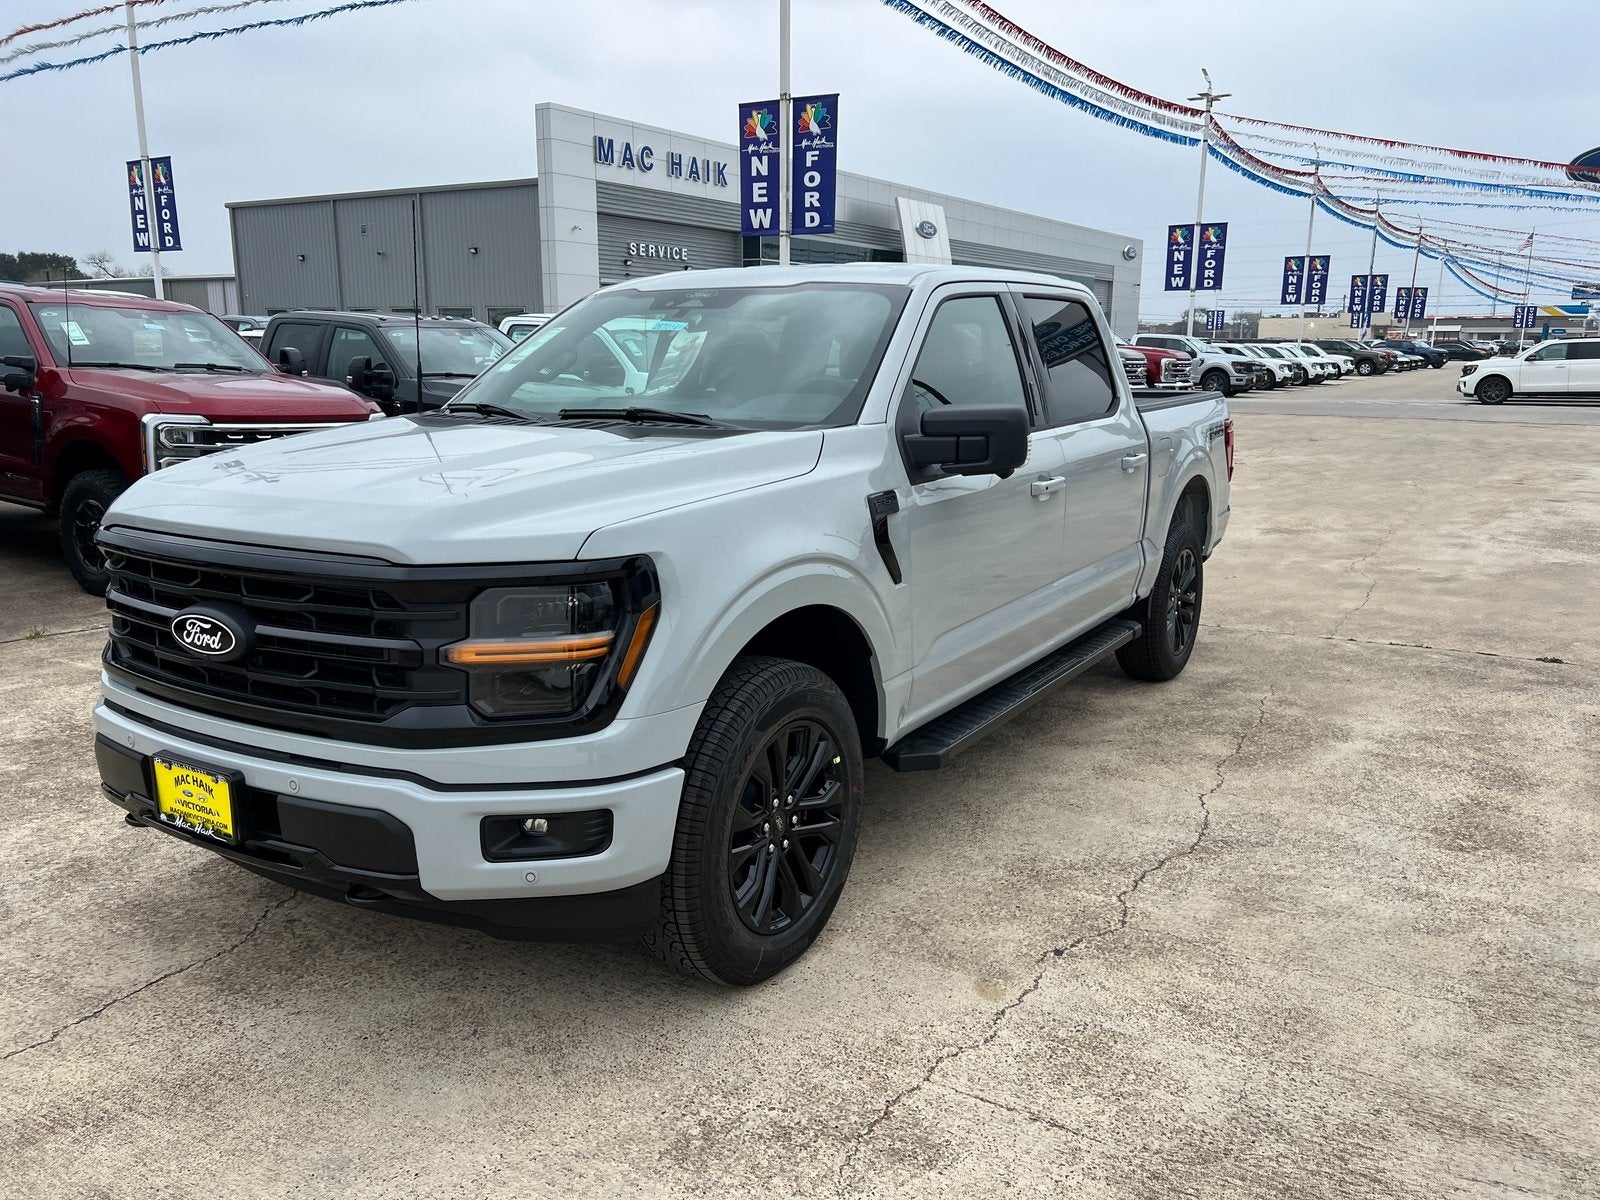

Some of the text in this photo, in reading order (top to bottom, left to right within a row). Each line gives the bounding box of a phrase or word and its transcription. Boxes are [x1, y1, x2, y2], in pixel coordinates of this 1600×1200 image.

[595, 135, 728, 187] MAC HAIK
[749, 155, 773, 229] NEW
[803, 150, 821, 228] FORD
[134, 196, 148, 247] NEW
[161, 195, 174, 247] FORD
[629, 242, 689, 260] SERVICE
[1170, 250, 1185, 288] NEW
[1203, 249, 1216, 288] FORD
[1285, 275, 1298, 303] NEW
[1311, 274, 1321, 303] FORD
[1352, 290, 1362, 311] NEW
[1372, 289, 1381, 311] FORD
[1397, 299, 1406, 317] NEW
[1414, 299, 1422, 318] FORD
[183, 619, 222, 650] Ford
[174, 774, 215, 800] MAC HAIK
[181, 800, 214, 817] VICTORIA
[174, 815, 219, 838] Mac Haik
